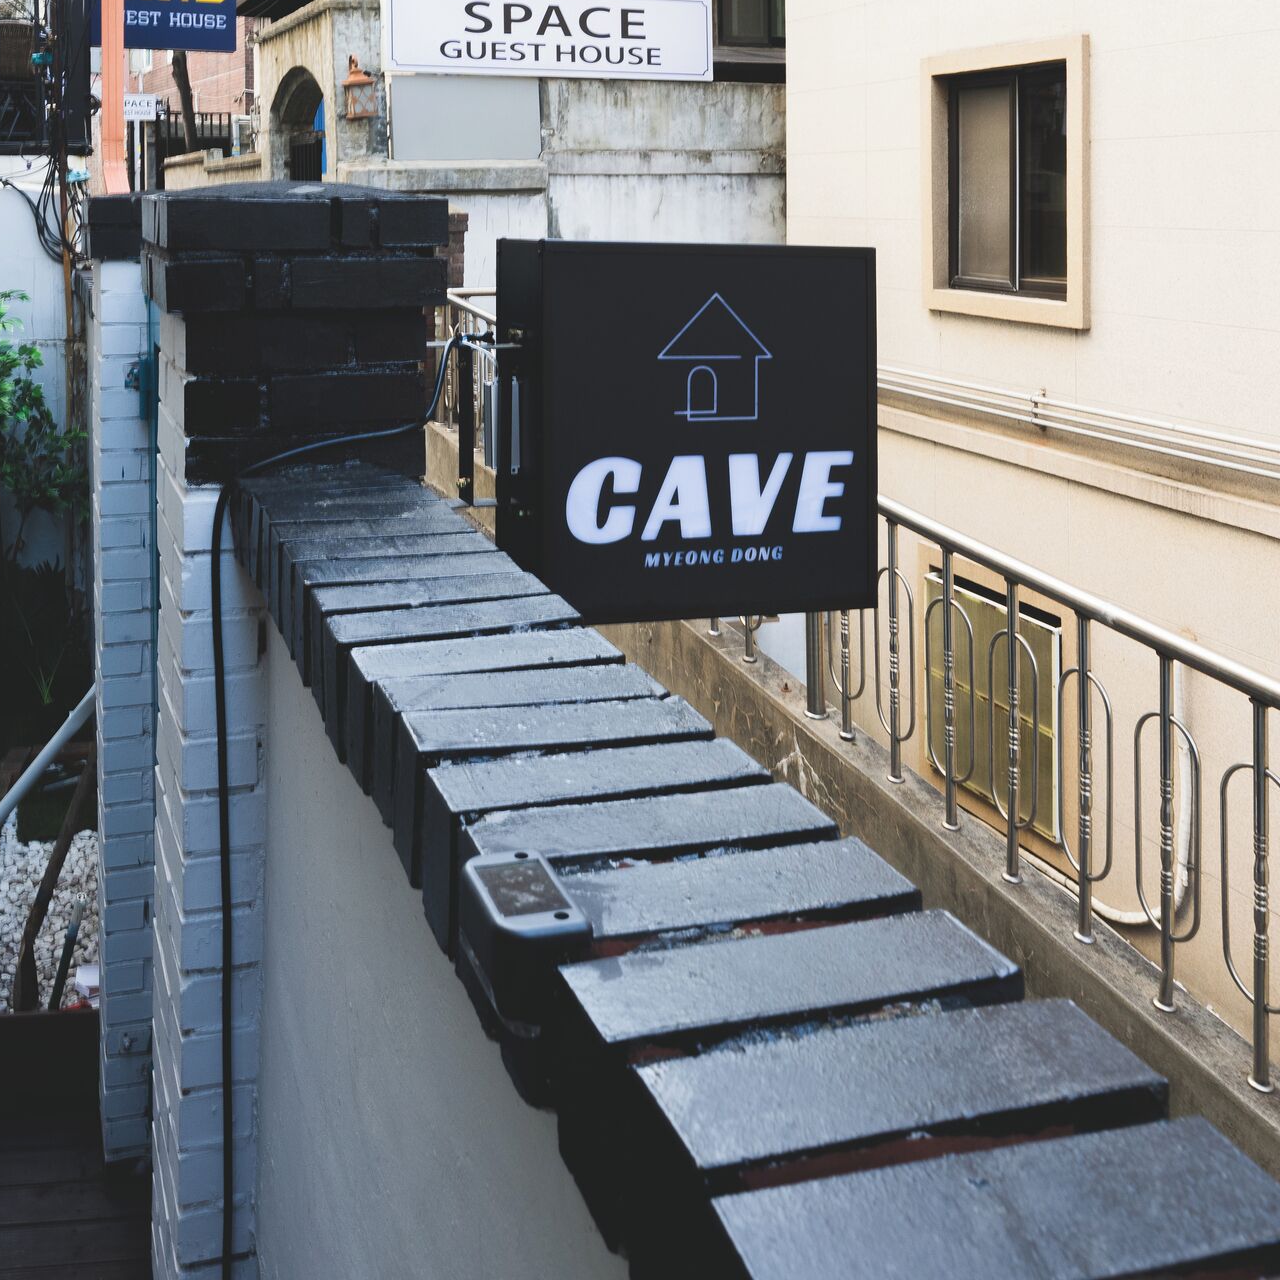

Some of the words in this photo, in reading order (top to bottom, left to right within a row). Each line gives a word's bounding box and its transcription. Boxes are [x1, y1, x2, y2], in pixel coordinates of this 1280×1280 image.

[123, 10, 161, 27] EST
[169, 11, 227, 29] HOUSE
[464, 1, 646, 40] SPACE
[439, 40, 546, 63] GUEST
[556, 44, 662, 67] HOUSE
[566, 450, 854, 545] CAVE
[644, 548, 725, 568] MYEONG
[730, 545, 783, 563] DONG
